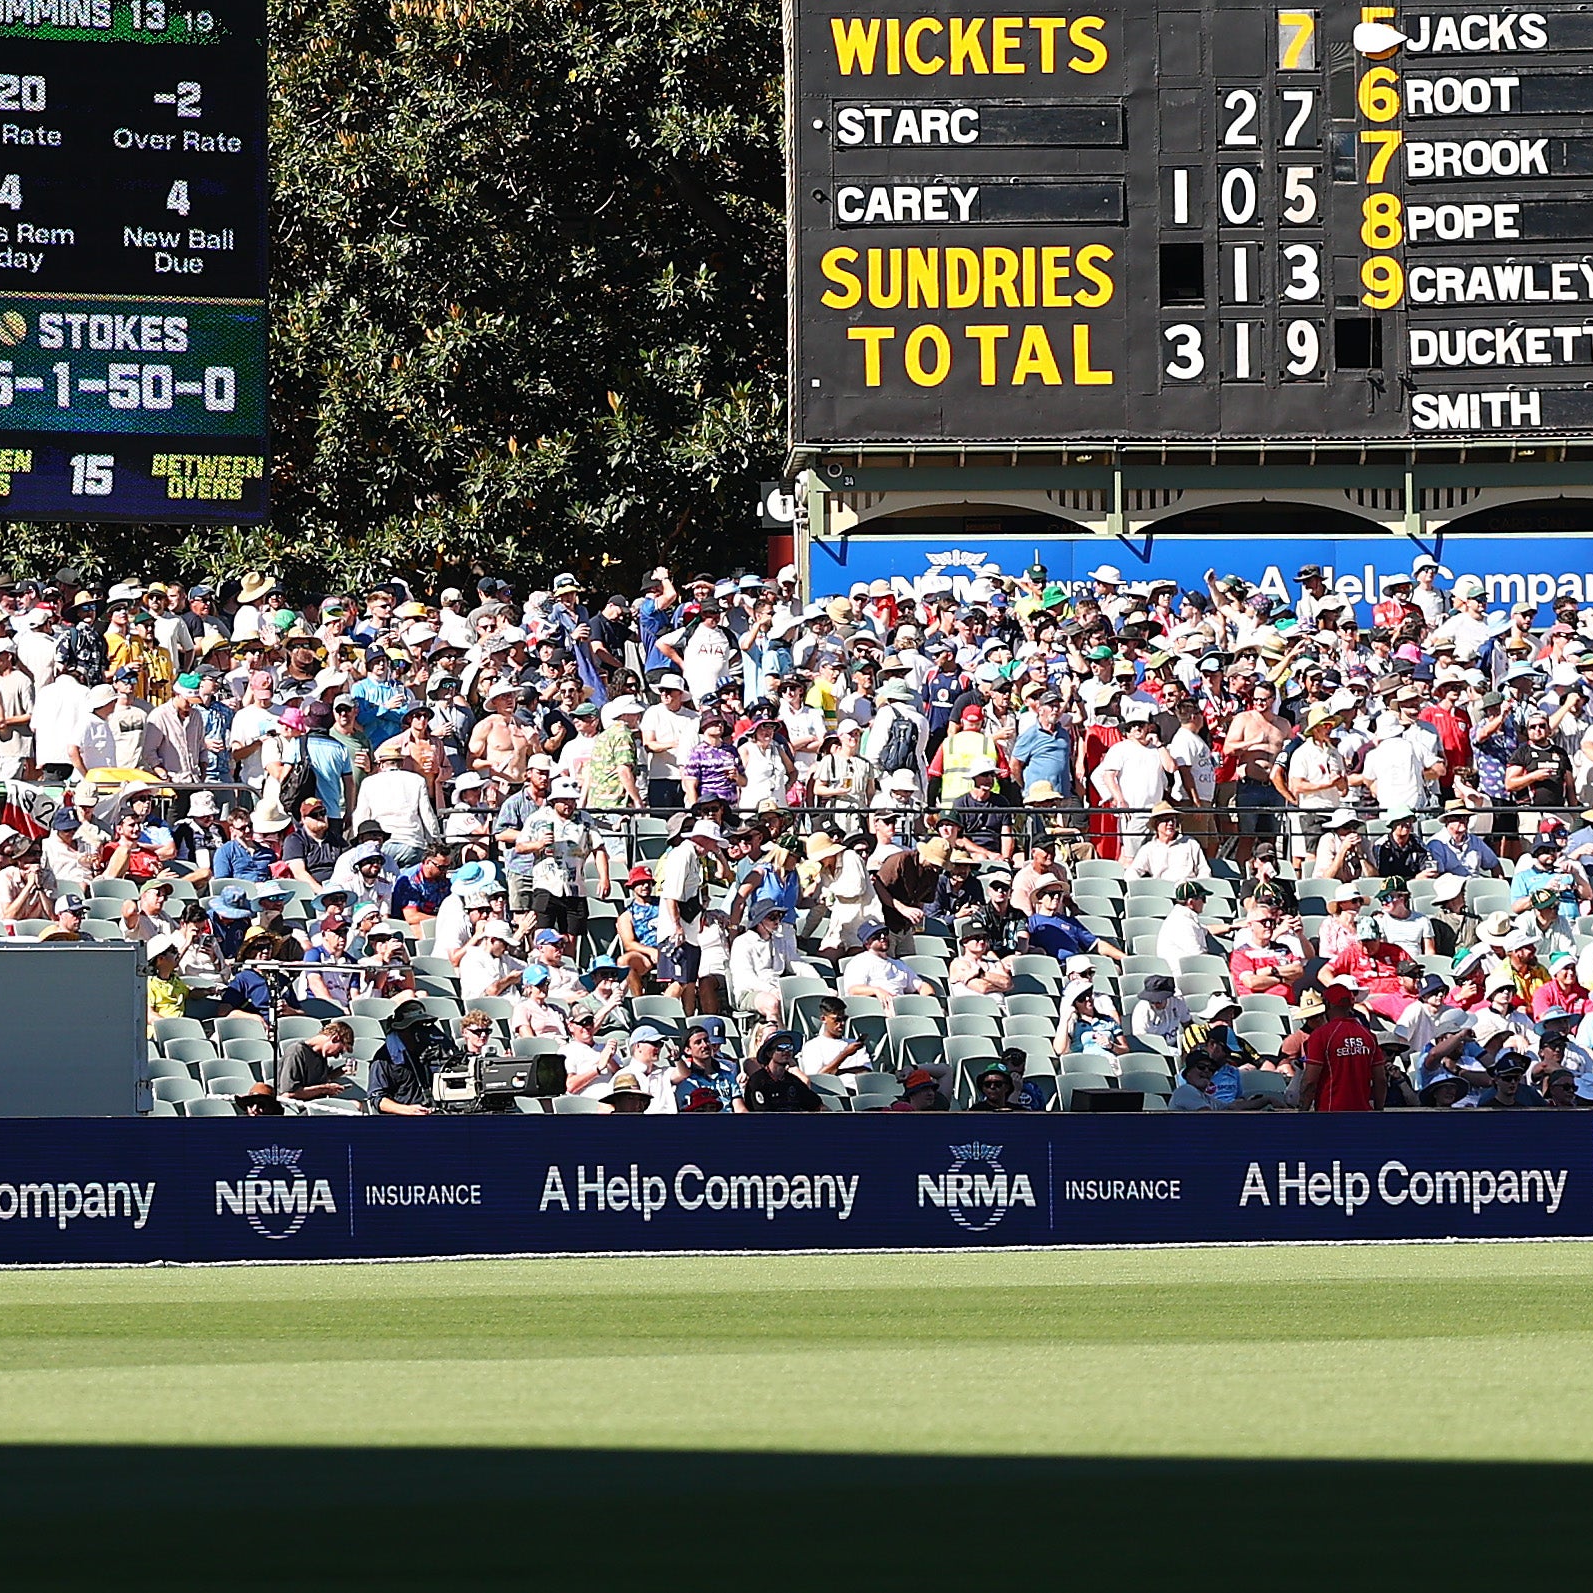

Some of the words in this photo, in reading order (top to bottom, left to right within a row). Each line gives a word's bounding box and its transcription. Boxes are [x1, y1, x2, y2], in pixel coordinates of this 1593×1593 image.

[130, 0, 167, 31] 13
[184, 9, 215, 34] 19
[1405, 15, 1549, 53] JACKS
[830, 15, 1109, 76] WICKETS
[1407, 77, 1520, 115] ROOT
[2, 123, 63, 148] Rate
[113, 127, 176, 152] Over
[182, 130, 242, 154] Rate
[837, 108, 980, 145] STARC
[1407, 139, 1550, 178] BROOK
[166, 179, 191, 216] 4
[837, 185, 980, 223] CAREY
[17, 223, 75, 246] Rem
[123, 226, 183, 251] New
[189, 227, 235, 252] Ball
[1408, 204, 1521, 242] POPE
[154, 251, 205, 275] Due
[819, 243, 1115, 309] SUNDRIES
[38, 313, 189, 352] STOKES
[848, 323, 1113, 387] TOTAL
[1412, 390, 1541, 431] SMITH
[70, 453, 115, 496] 15
[152, 454, 264, 479] BETWEEN
[167, 477, 243, 501] OVERS
[918, 1174, 1036, 1207] NRMA
[1065, 1179, 1181, 1200] INSURANCE
[1239, 1162, 1269, 1206] A
[1278, 1159, 1371, 1216] Help
[1378, 1160, 1568, 1215] Company
